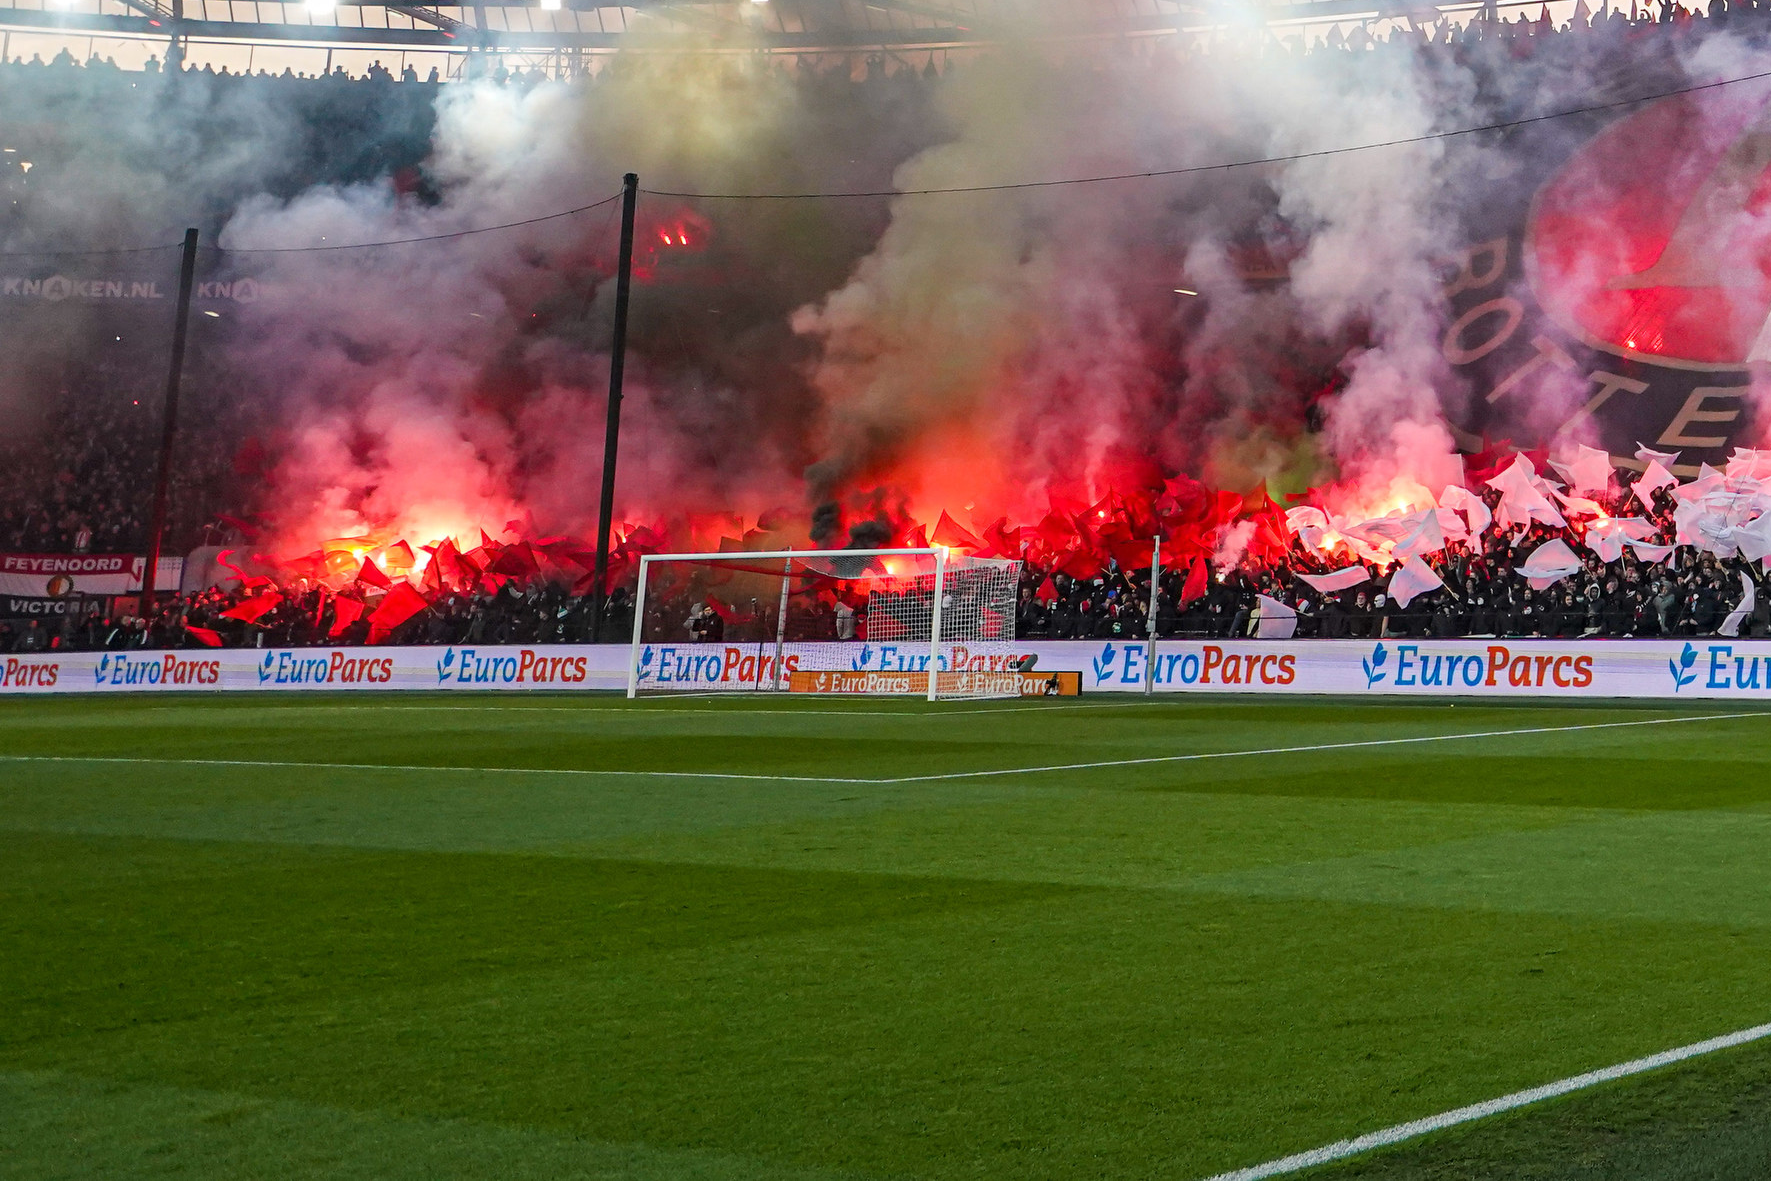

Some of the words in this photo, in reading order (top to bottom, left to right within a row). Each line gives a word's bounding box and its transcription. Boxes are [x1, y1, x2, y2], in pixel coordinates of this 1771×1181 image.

[4, 556, 123, 572] FEYENOORD
[110, 654, 220, 685] EuroParcs
[275, 651, 393, 684] EuroParcs
[457, 649, 587, 683] EuroParcs
[1120, 644, 1296, 685] EuroParcs
[1394, 645, 1593, 688] EuroParcs
[831, 673, 910, 693] EuroParcs
